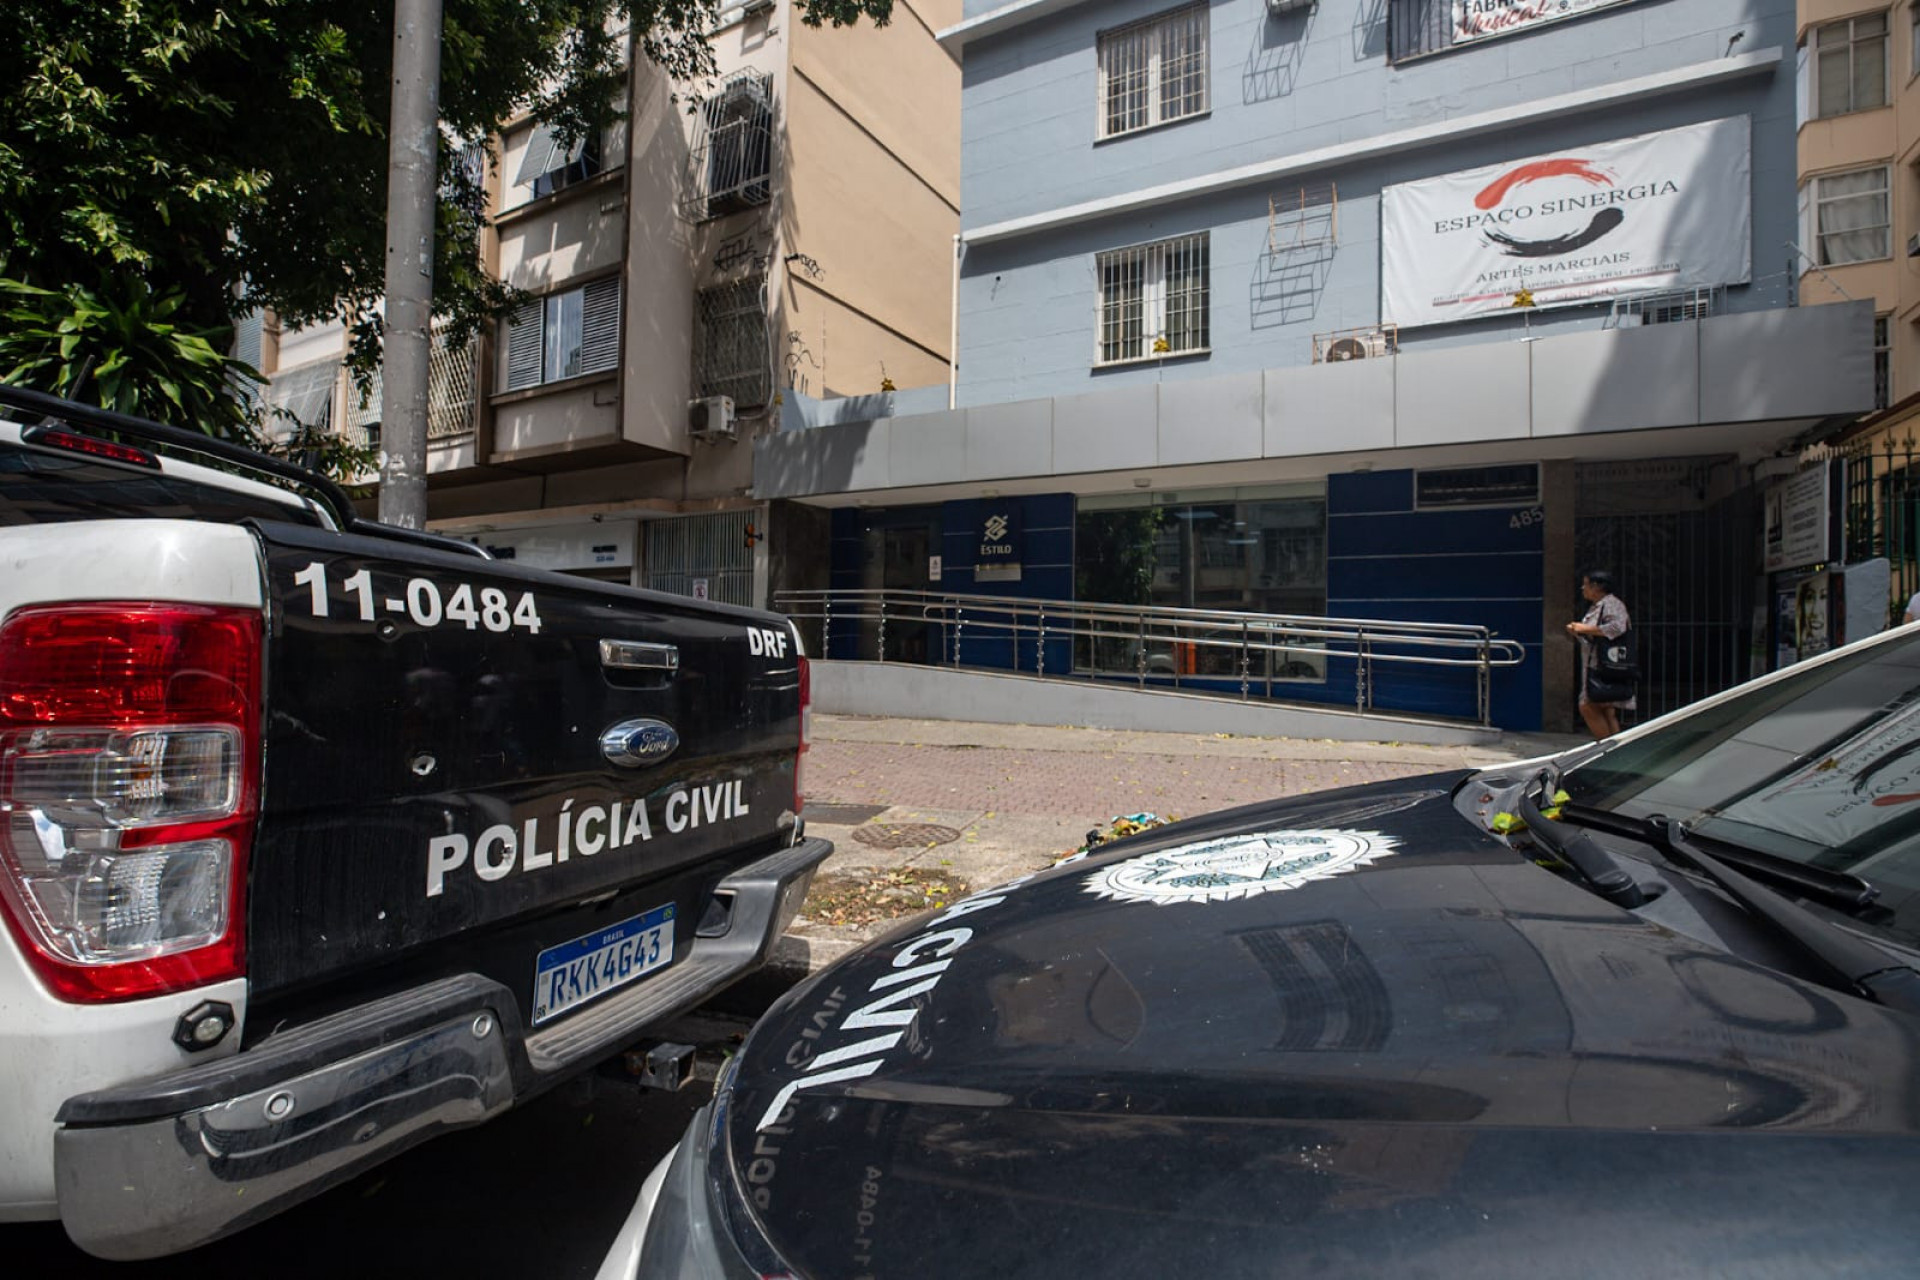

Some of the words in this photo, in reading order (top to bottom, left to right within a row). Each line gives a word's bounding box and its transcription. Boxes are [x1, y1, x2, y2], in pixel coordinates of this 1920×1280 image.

[1434, 205, 1533, 234] ESPAÇO
[1540, 179, 1679, 216] SINERGIA
[1475, 264, 1534, 284] ARTES
[1538, 251, 1631, 275] MARCIAIS
[1509, 507, 1544, 529] 485
[980, 544, 1012, 555] ESTILO
[294, 562, 541, 634] 11-0484
[747, 626, 787, 659] DRF
[638, 731, 669, 753] Ford
[426, 799, 652, 897] POLÍCIA
[665, 779, 749, 833] CIVIL
[603, 930, 625, 945] BRASIL
[550, 928, 660, 1010] RKK4G43
[756, 927, 973, 1133] CIVIL
